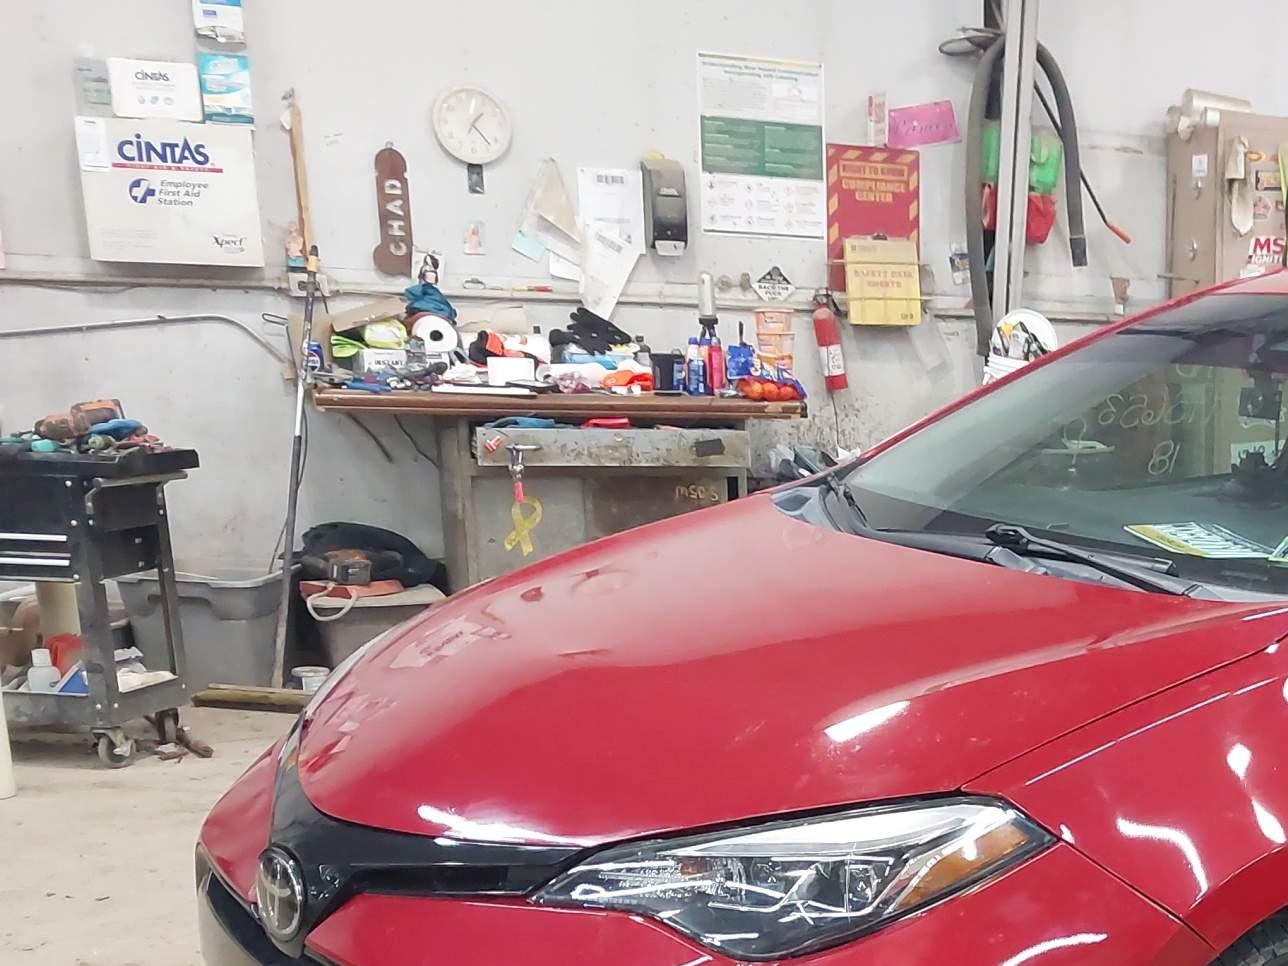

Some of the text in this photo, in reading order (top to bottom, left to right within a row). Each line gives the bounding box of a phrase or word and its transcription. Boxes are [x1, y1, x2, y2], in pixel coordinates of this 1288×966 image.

[117, 133, 209, 166] CINTAS
[160, 180, 208, 192] Employee
[158, 188, 201, 198] First Aid
[855, 191, 893, 203] CENTER
[157, 197, 193, 207] Station
[384, 178, 408, 256] CHAD
